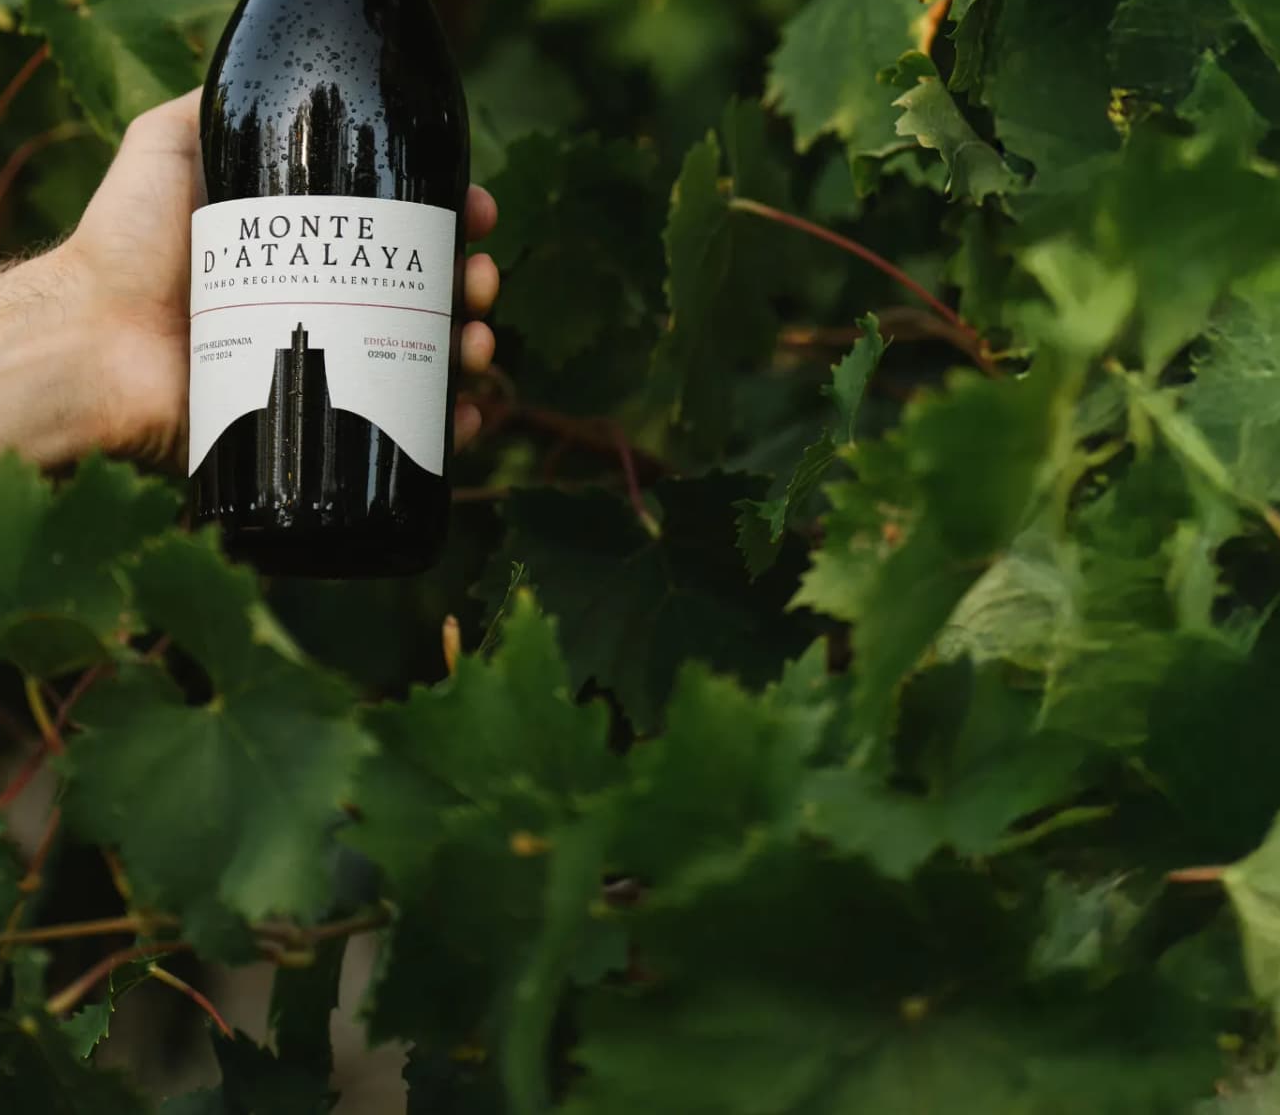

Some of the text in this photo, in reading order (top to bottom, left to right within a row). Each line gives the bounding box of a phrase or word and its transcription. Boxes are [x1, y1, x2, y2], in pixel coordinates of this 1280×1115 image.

[239, 215, 375, 240] MONTE
[204, 243, 424, 273] D'ATALAYA
[204, 275, 425, 291] VINHO REGIONAL ALENTEJANO
[363, 337, 438, 353] EDIÇÃO LIMITADA
